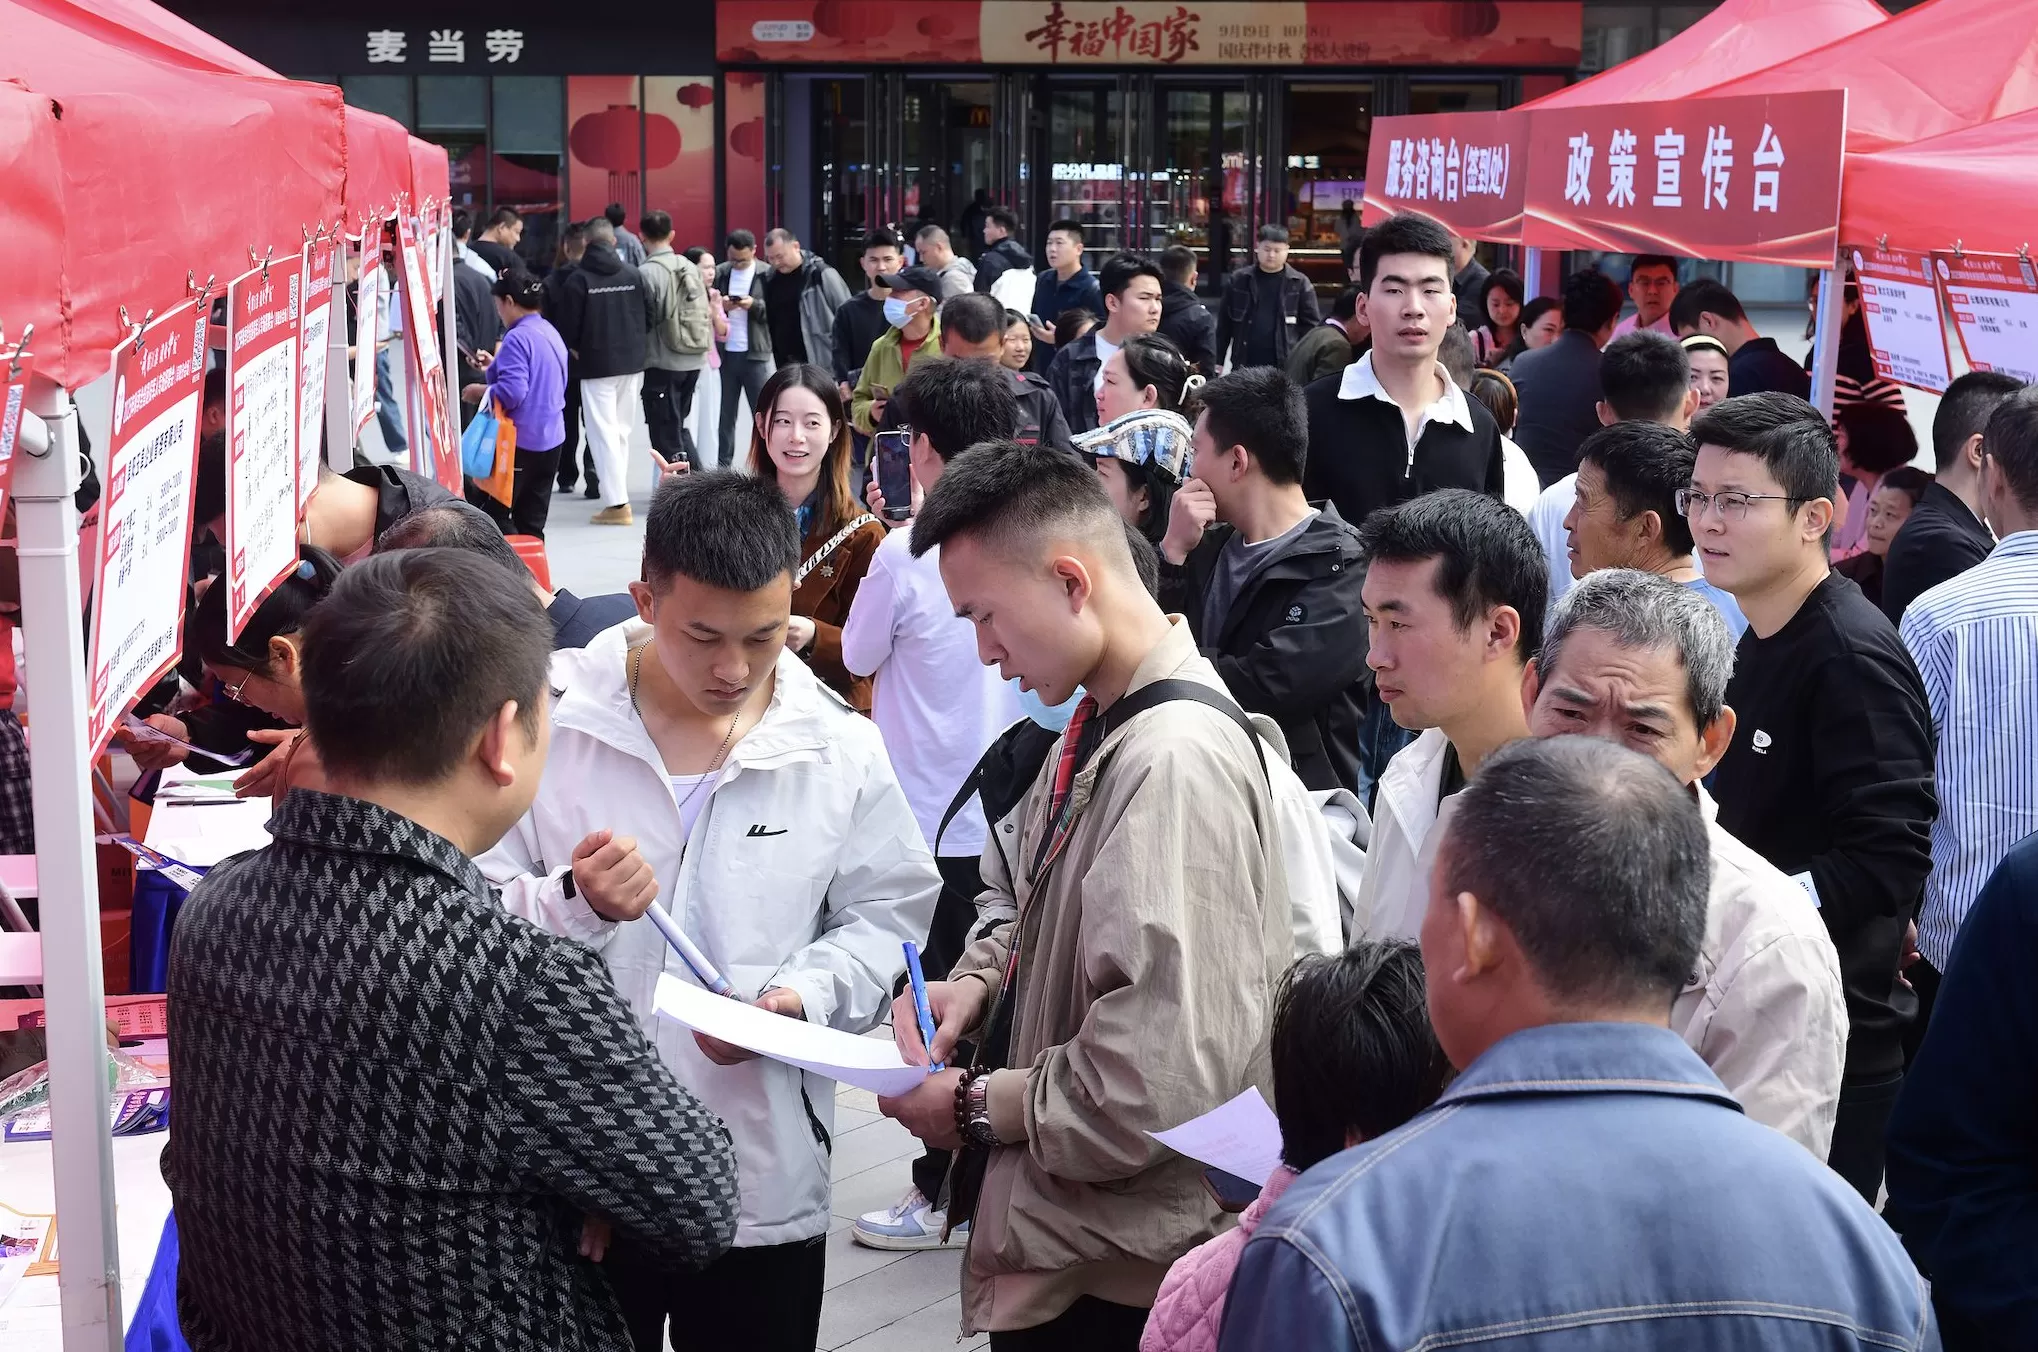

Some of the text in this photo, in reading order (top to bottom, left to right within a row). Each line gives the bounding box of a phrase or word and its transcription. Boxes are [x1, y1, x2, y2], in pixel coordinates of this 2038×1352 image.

[366, 29, 524, 63] 麦当劳
[1025, 2, 1200, 64] 幸福中国家
[1564, 123, 1786, 214] 政策宣传台
